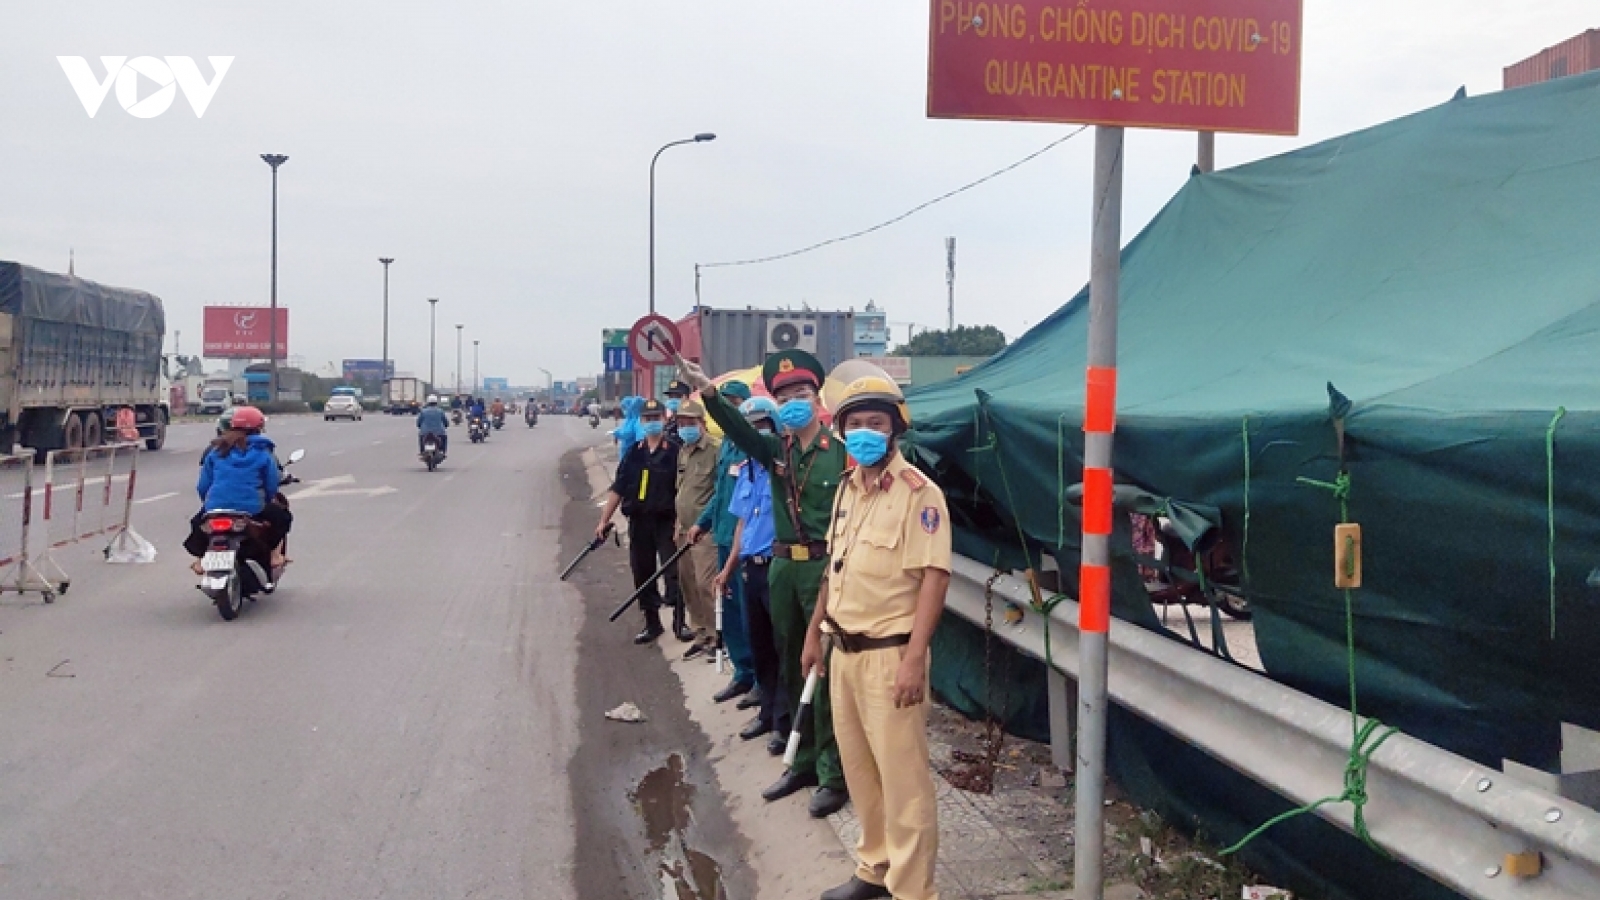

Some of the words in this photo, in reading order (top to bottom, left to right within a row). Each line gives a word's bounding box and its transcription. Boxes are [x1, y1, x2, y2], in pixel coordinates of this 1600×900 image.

[1039, 0, 1123, 45] CHỐNG
[1131, 11, 1186, 54] DỊCH
[1191, 15, 1291, 55] COVID-19
[984, 59, 1141, 102] QUARANTINE
[1151, 68, 1246, 108] STATION
